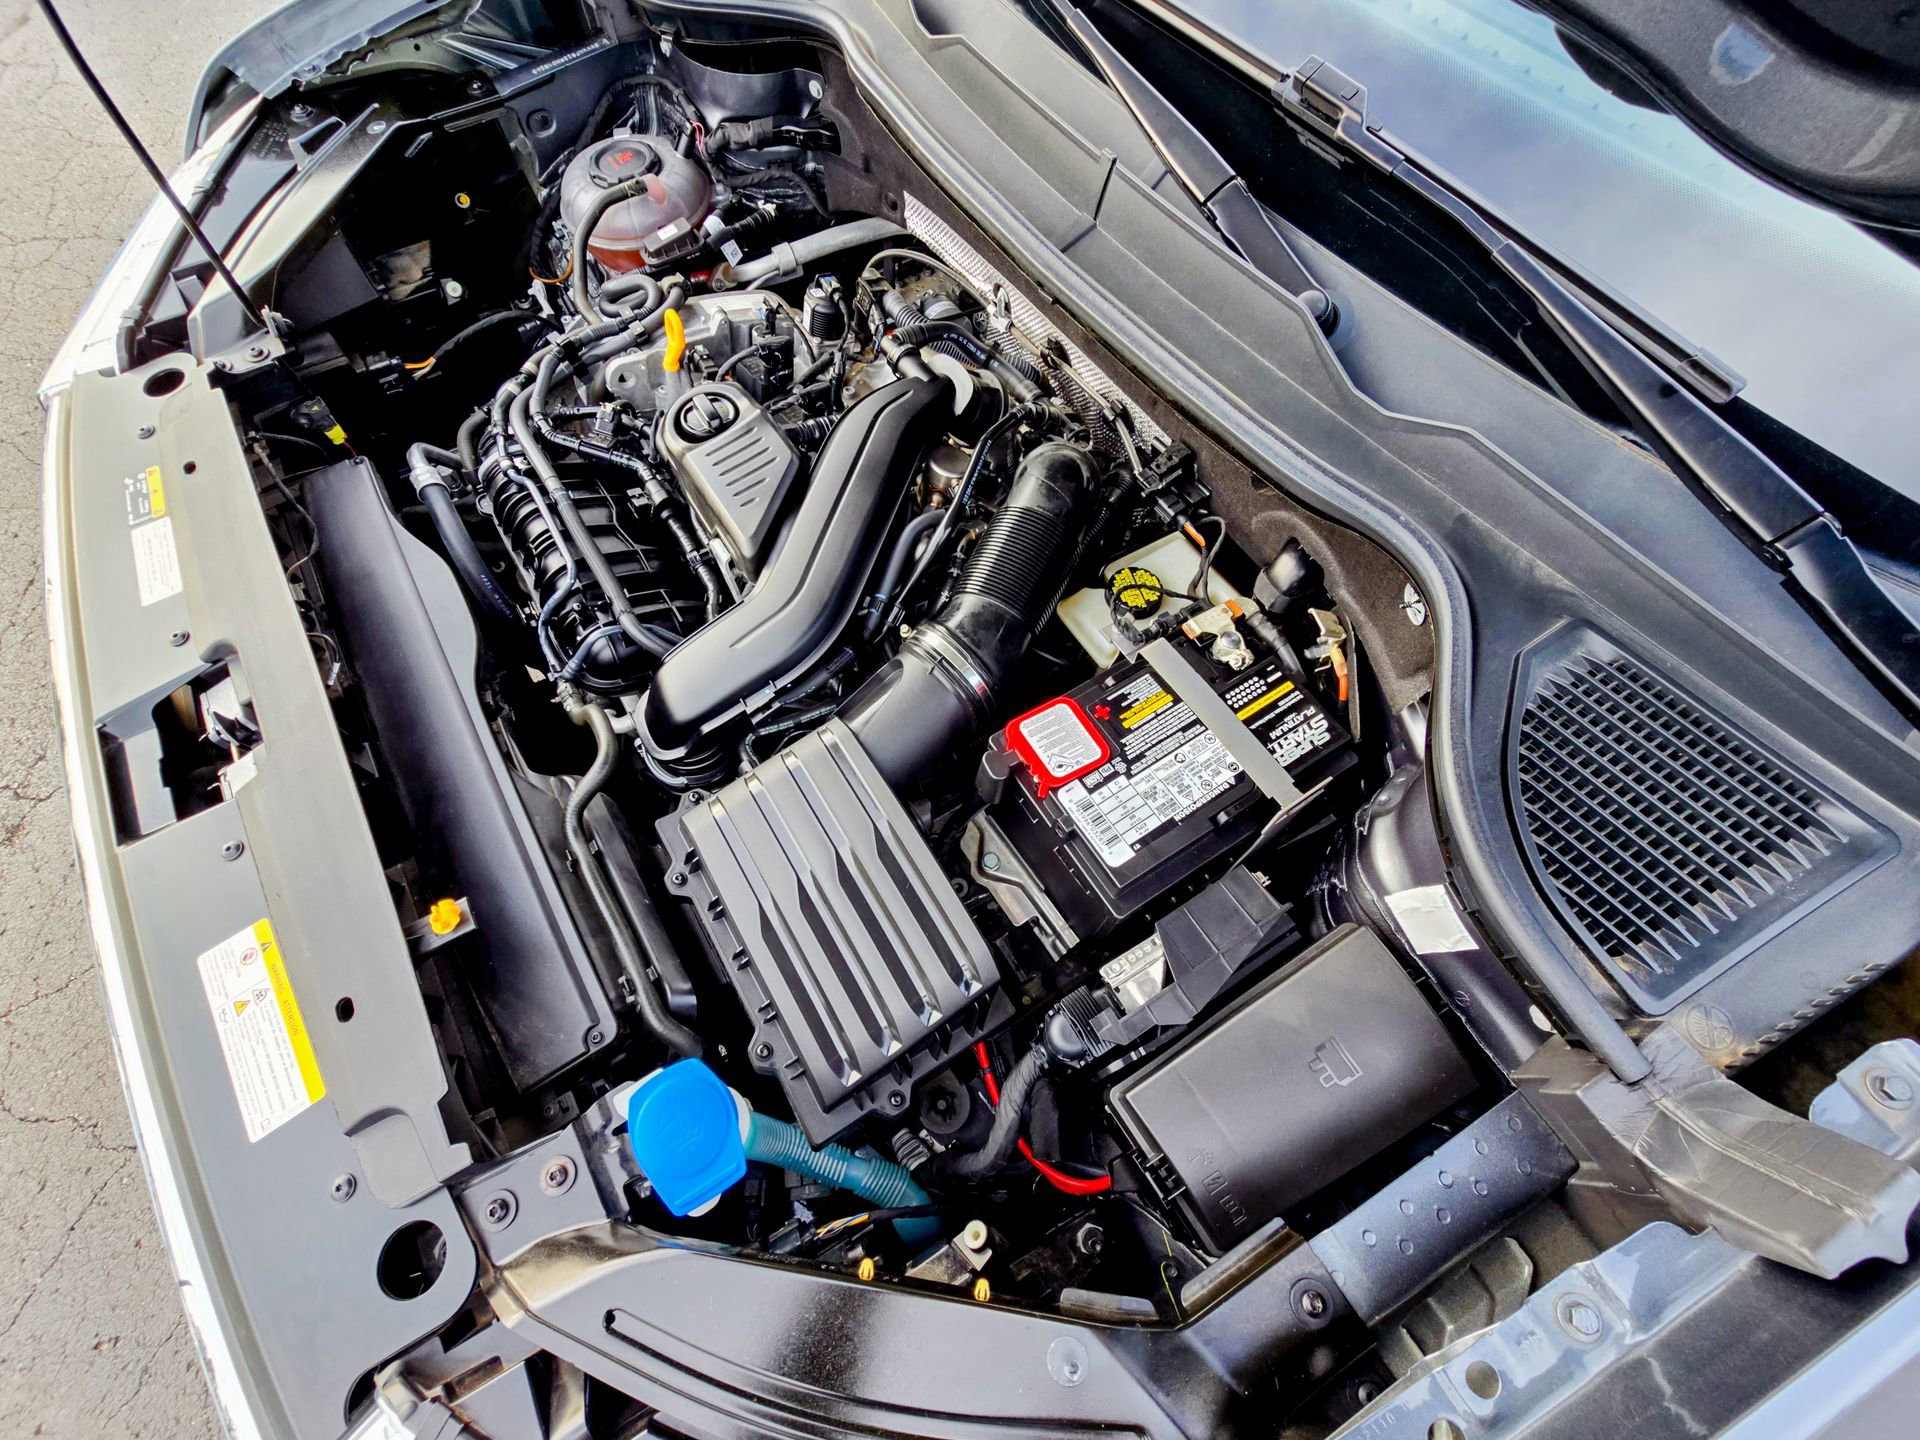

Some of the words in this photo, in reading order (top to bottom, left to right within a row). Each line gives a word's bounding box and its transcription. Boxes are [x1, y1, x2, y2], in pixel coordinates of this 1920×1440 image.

[1268, 713, 1329, 759] START
[1269, 705, 1317, 740] PLATINUM
[1276, 728, 1332, 768] SUPER
[1101, 765, 1111, 775] Pb
[282, 999, 300, 1036] ATTENTION
